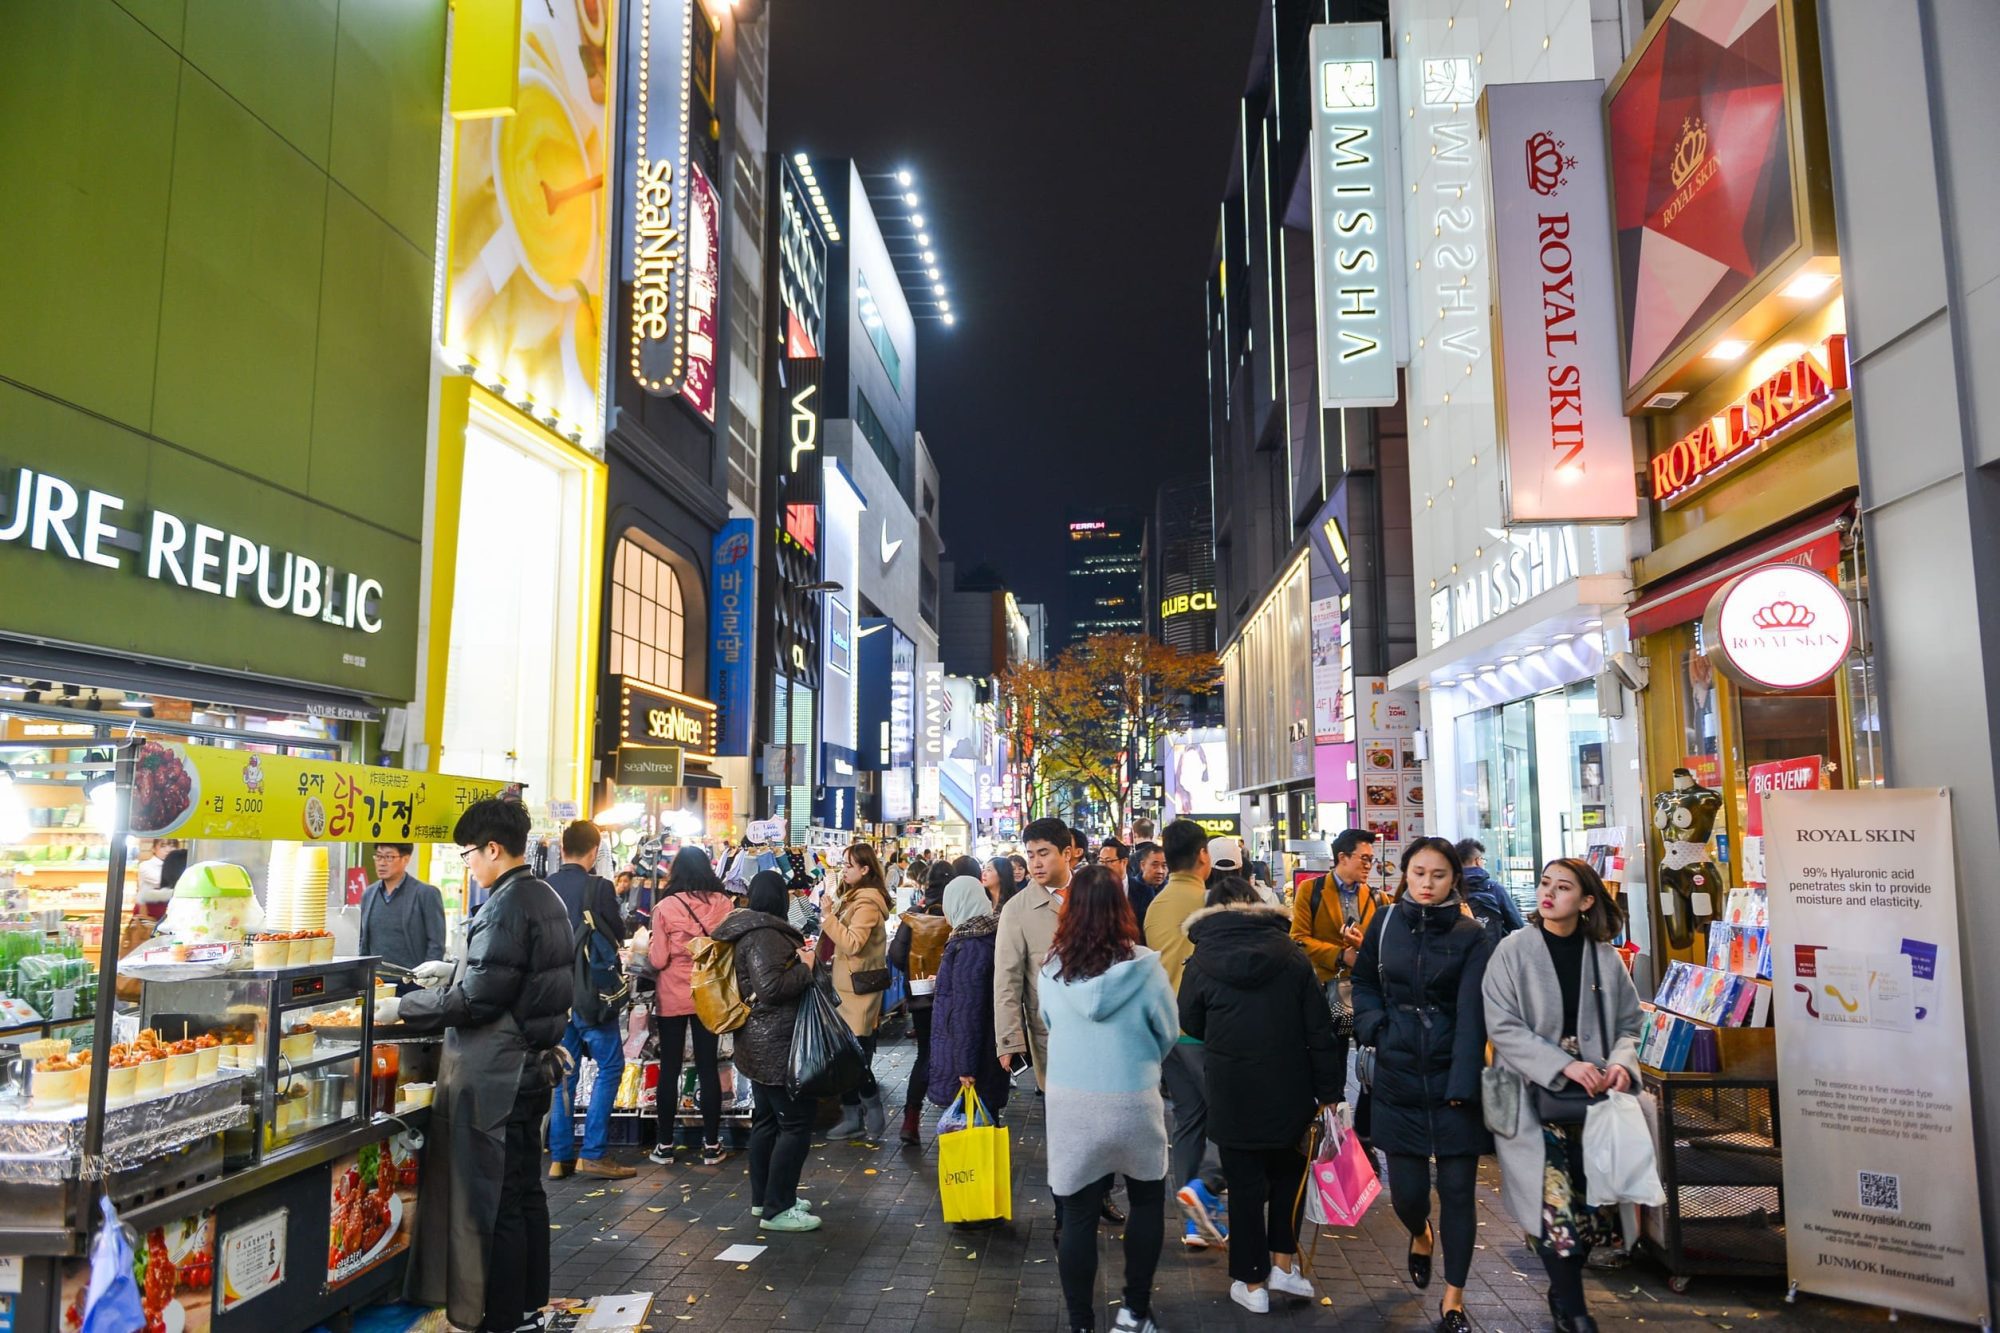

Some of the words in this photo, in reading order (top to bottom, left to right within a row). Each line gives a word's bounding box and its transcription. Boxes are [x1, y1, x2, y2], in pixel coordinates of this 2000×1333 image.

[1663, 183, 1696, 229] ROYAL
[1696, 149, 1723, 192] SKIN
[637, 158, 678, 340] seaNtree
[1332, 124, 1378, 363] MISSHA
[1537, 210, 1580, 357] ROYAL
[1546, 362, 1586, 474] SKIN
[1651, 404, 1748, 501] ROYAL
[1747, 334, 1849, 442] SKIN
[147, 509, 384, 634] REPUBLIC
[1455, 525, 1580, 638] MISSHA
[716, 569, 745, 664] 바오로딸
[1733, 635, 1789, 650] ROYAL
[1796, 633, 1839, 647] SKIN
[306, 704, 336, 717] NATURE
[338, 707, 371, 719] REPUBLIC
[926, 670, 942, 754] KLAVUU
[648, 705, 702, 745] seaNtree
[624, 761, 673, 773] seaNtree
[297, 773, 325, 795] 유자
[1754, 773, 1772, 794] BIG
[1774, 768, 1812, 791] EVENT
[213, 796, 224, 813] 컵
[234, 799, 264, 816] 5,000
[1796, 829, 1863, 843] ROYAL
[1865, 829, 1916, 843] SKIN
[1802, 867, 1828, 878] 99%
[1830, 868, 1889, 880] Hyaluronic
[1891, 869, 1915, 880] acid
[1789, 881, 1846, 892] penetrates
[1849, 882, 1872, 893] skin
[1875, 883, 1887, 893] to
[1890, 883, 1932, 895] provide
[1796, 895, 1843, 906] moisture
[1846, 896, 1866, 906] and
[1870, 897, 1923, 909] elasticity.
[1822, 1013, 1848, 1023] ROYAL
[1849, 1015, 1869, 1024] SKIN
[1797, 1088, 1834, 1099] penetrates
[1836, 1091, 1847, 1100] the
[1899, 1098, 1915, 1107] skin
[1925, 1101, 1953, 1112] provide
[1814, 1079, 1827, 1087] The
[1890, 1087, 1915, 1097] needle
[1816, 1100, 1846, 1110] effective
[1881, 1107, 1906, 1118] deeply
[1837, 1112, 1848, 1121] the
[1850, 1114, 1871, 1125] patch
[1903, 1120, 1918, 1130] give
[1821, 1121, 1852, 1132] moisture
[1853, 1124, 1867, 1134] and
[1832, 1208, 1932, 1232] www.royalskin.com
[1816, 1253, 1878, 1274] JUNMOK
[1881, 1264, 1956, 1288] International
